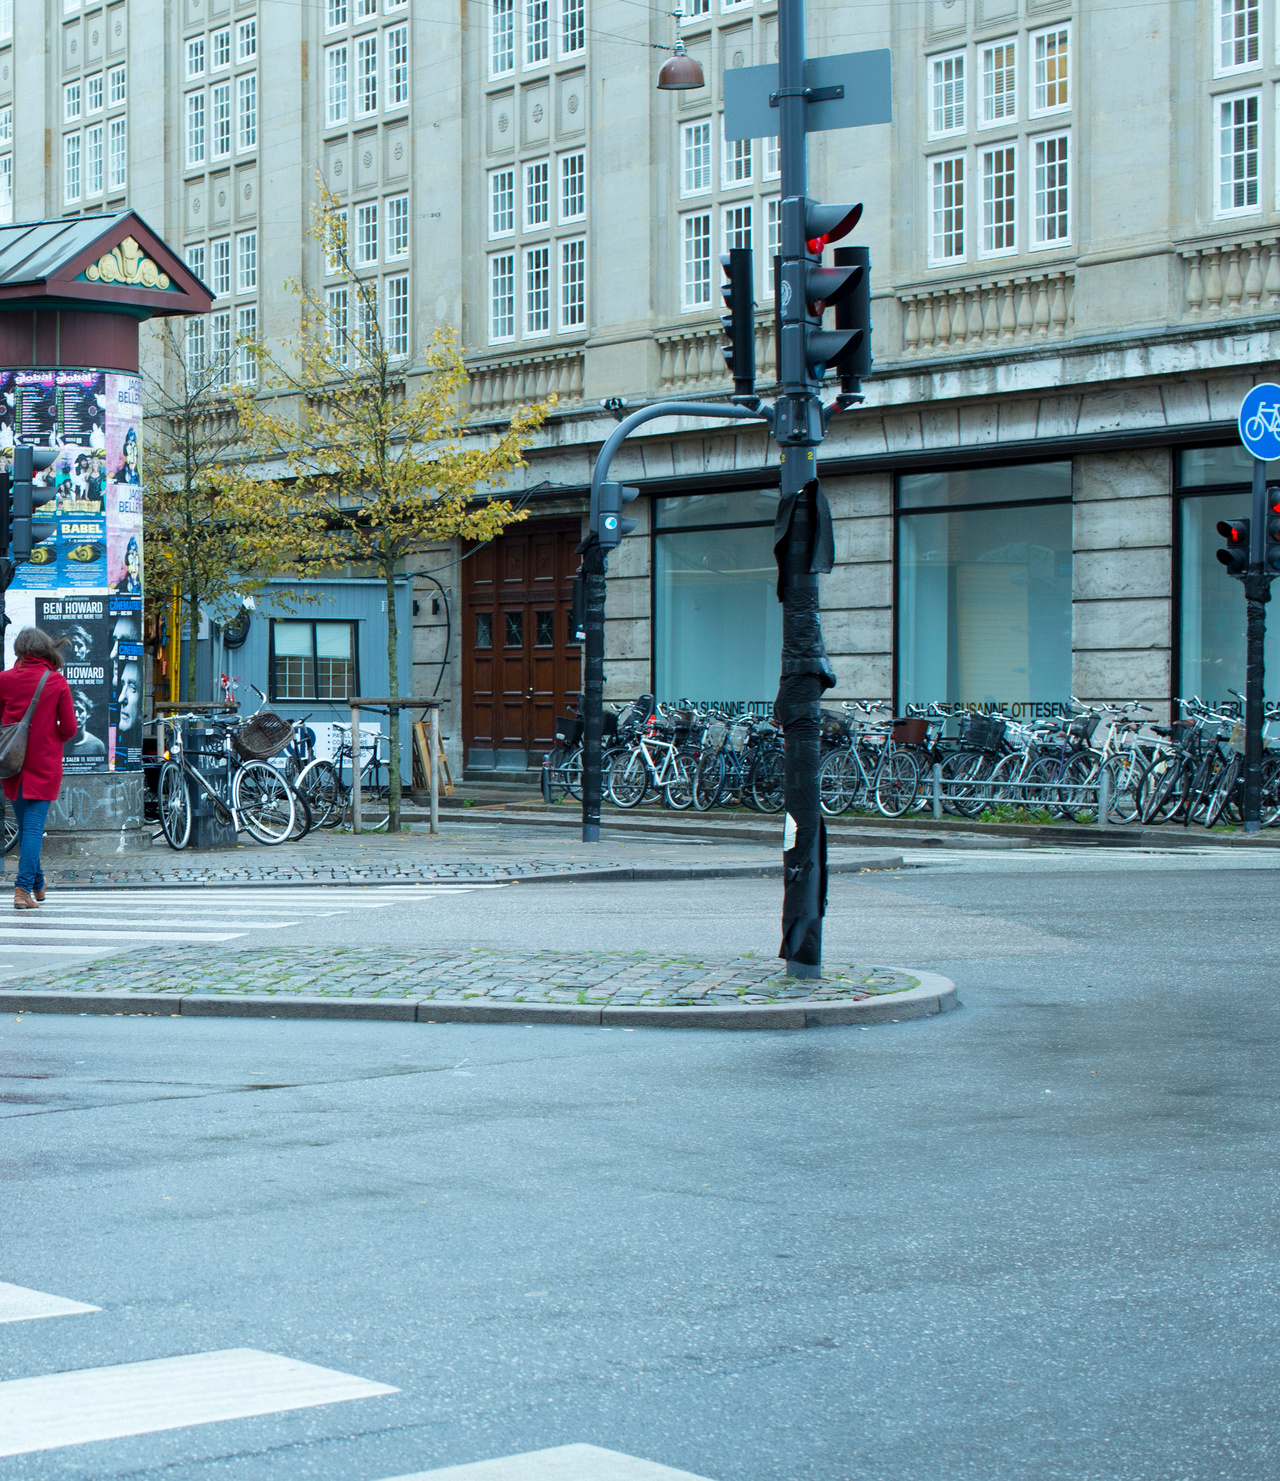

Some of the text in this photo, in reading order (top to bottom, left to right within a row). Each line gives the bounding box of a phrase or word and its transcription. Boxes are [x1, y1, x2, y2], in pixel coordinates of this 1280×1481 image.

[15, 373, 53, 385] global
[56, 373, 91, 386] global
[807, 451, 814, 460] 2
[61, 523, 103, 534] BABEL
[43, 601, 103, 614] BEN HOWARD
[66, 666, 104, 679] HOWARD
[700, 701, 745, 716] SUSANNE
[747, 701, 774, 715] OTTE
[953, 702, 1008, 717] SUSANNE
[1011, 702, 1068, 717] OTTESEN
